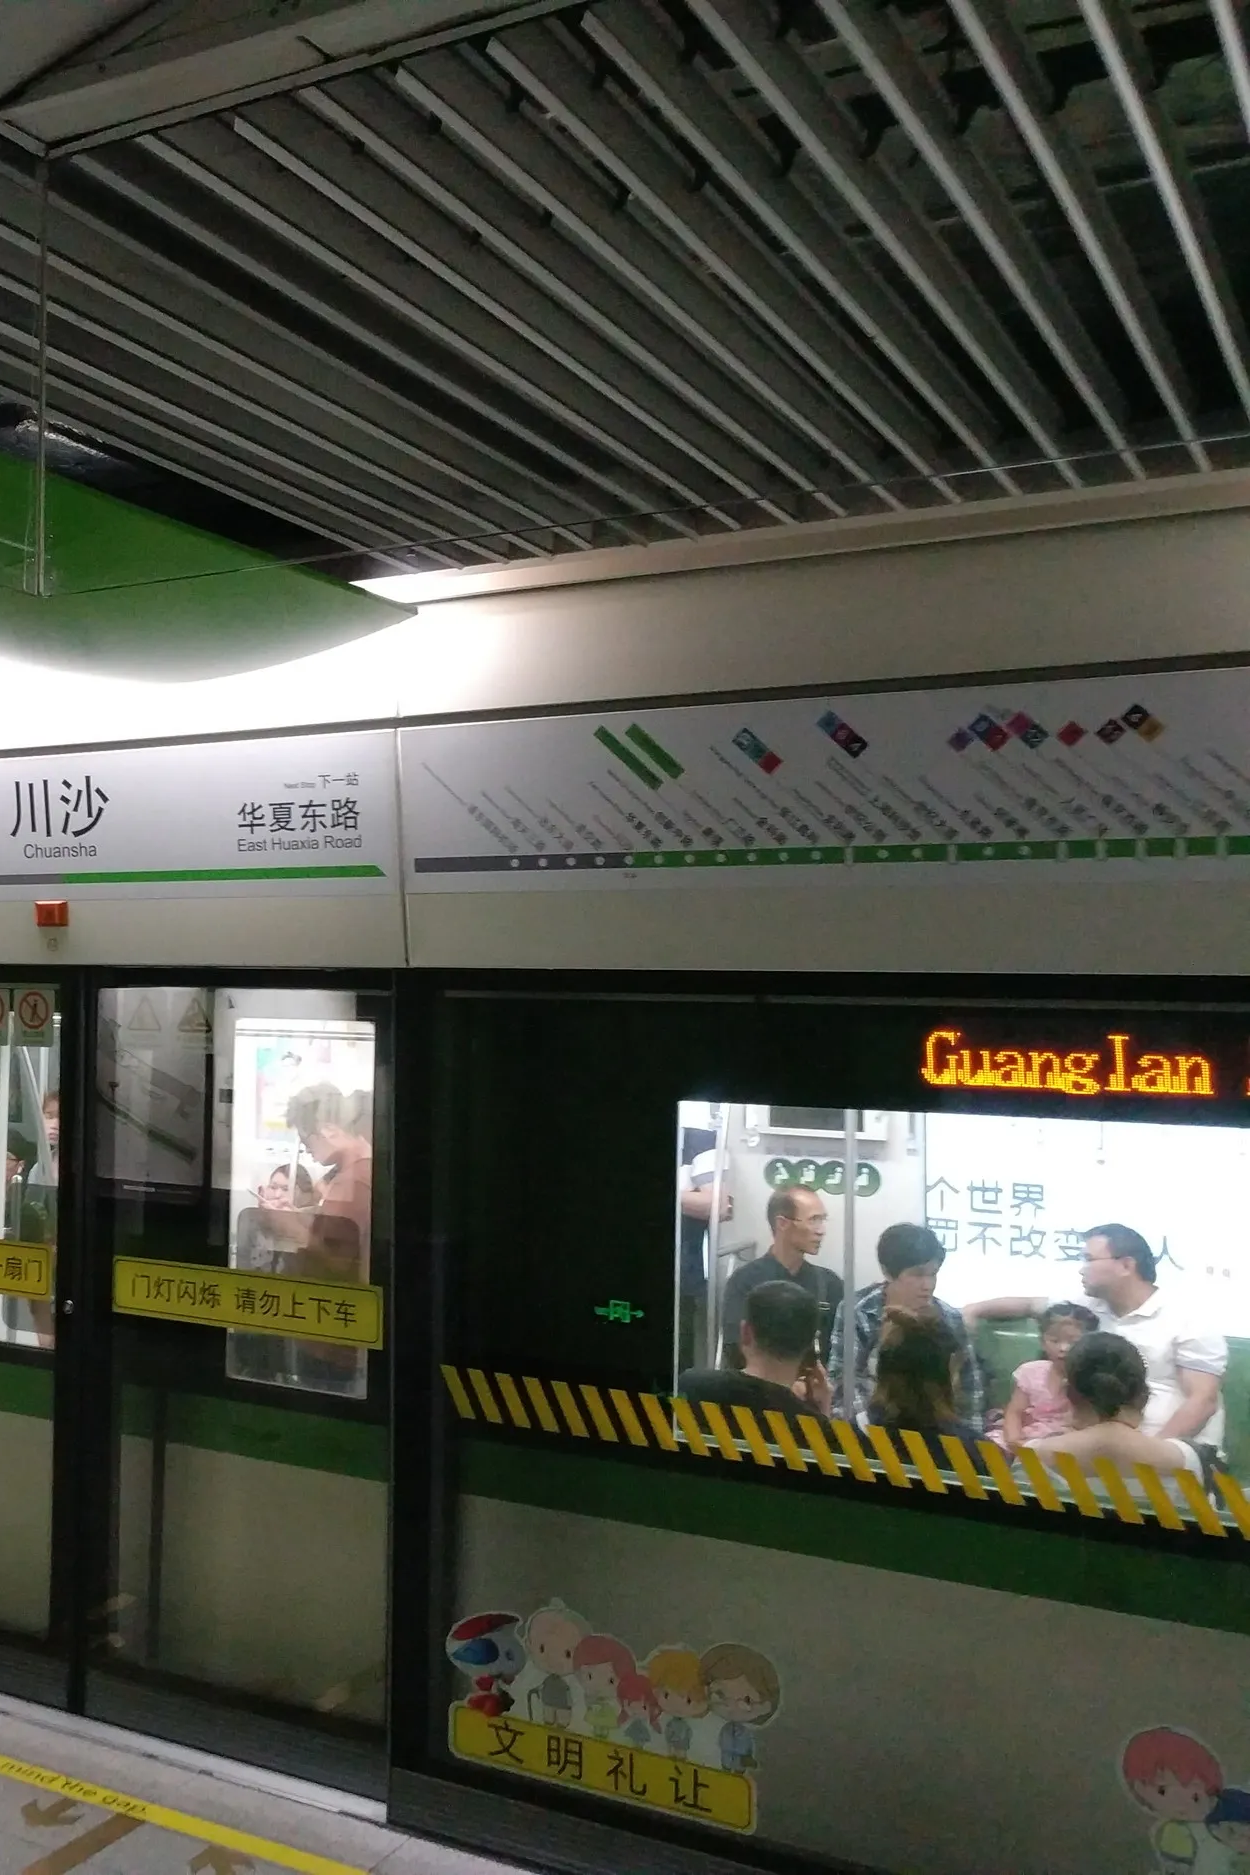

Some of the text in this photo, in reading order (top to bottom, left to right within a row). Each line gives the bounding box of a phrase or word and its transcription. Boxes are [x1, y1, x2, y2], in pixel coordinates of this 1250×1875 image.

[317, 772, 359, 789] 下一站
[10, 776, 110, 838] 川沙
[237, 797, 360, 834] 华夏东路
[23, 843, 98, 859] Chuansha
[237, 835, 363, 852] East Huaxia Road
[131, 1273, 358, 1328] 门灯闪烁 请勿上下车
[487, 1719, 713, 1813] 文明礼让
